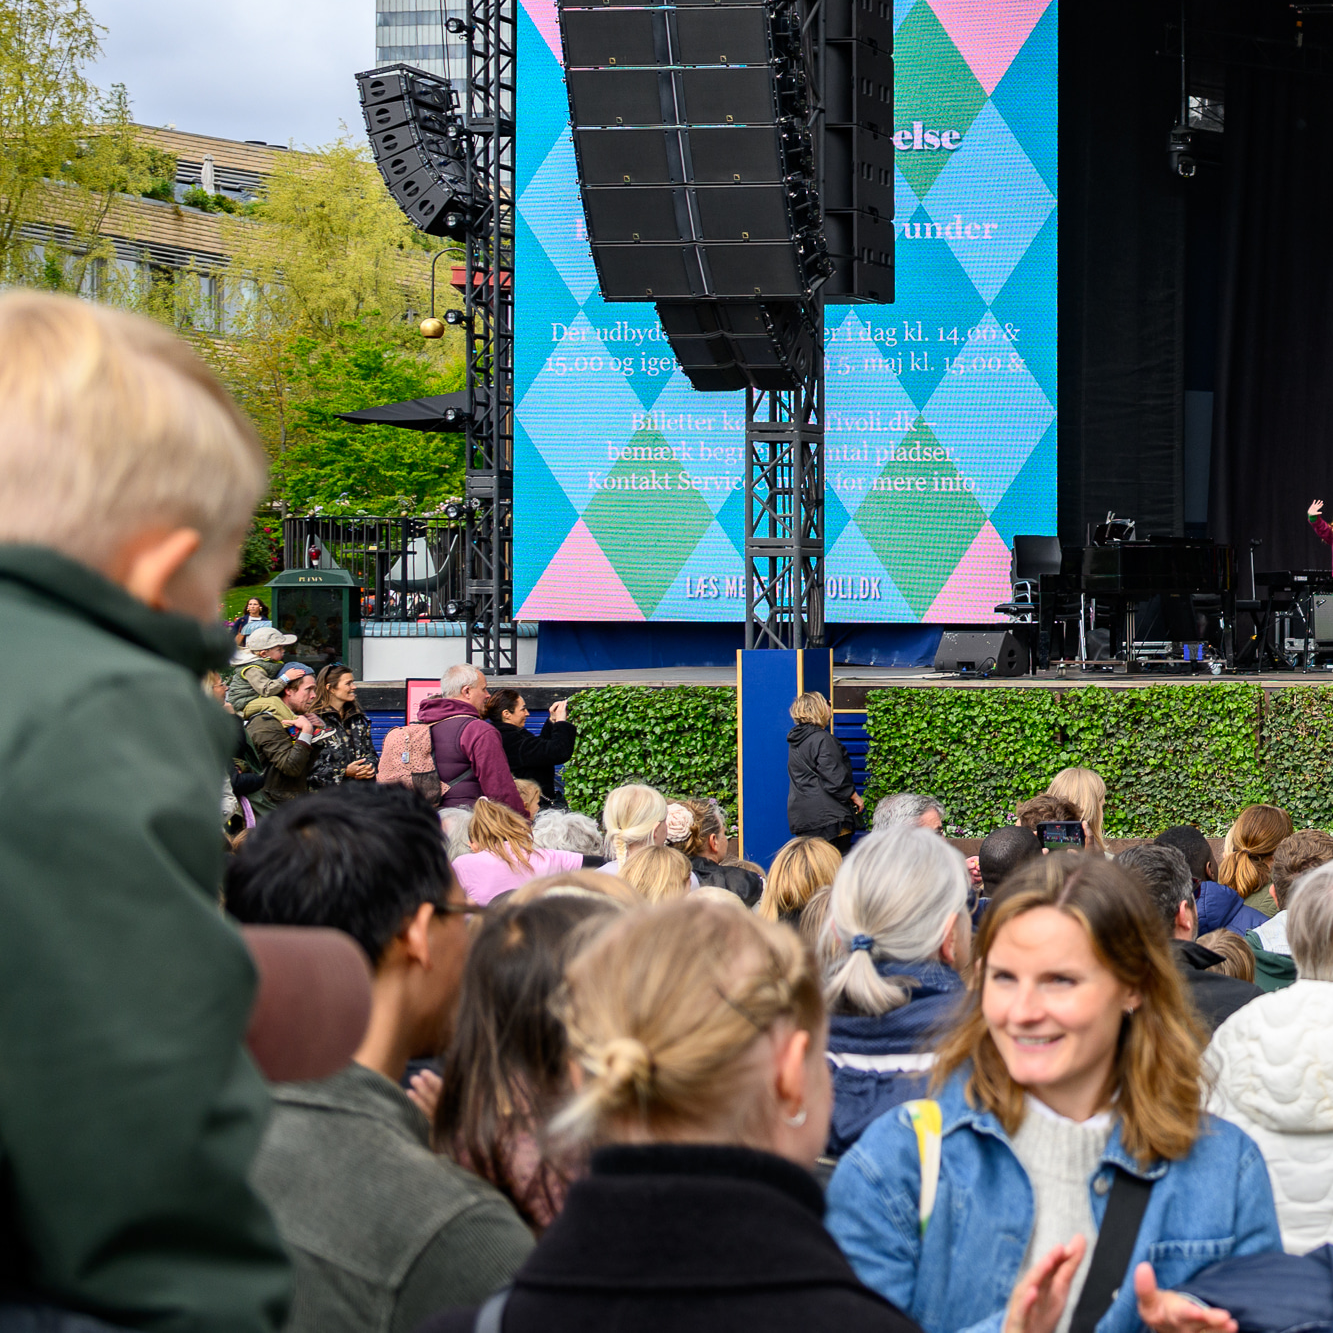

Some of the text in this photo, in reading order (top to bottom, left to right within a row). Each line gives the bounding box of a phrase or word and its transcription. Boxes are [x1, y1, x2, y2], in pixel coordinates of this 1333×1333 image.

[551, 322, 590, 342] Der
[846, 322, 853, 342] i
[859, 321, 897, 347] dag
[903, 321, 929, 342] kl.
[937, 326, 997, 345] 14.00
[1003, 322, 1021, 342] &
[545, 356, 603, 377] 15.00
[611, 356, 635, 377] og
[864, 352, 902, 376] maj
[909, 351, 935, 372] kl.
[943, 356, 1002, 375] 15.00
[1008, 351, 1026, 372] &
[631, 412, 717, 431] Billetter
[607, 441, 694, 462] bemærk
[876, 441, 960, 467] pladser.
[587, 470, 671, 491] Kontakt
[871, 475, 928, 492] mere
[686, 576, 720, 599] LÆS
